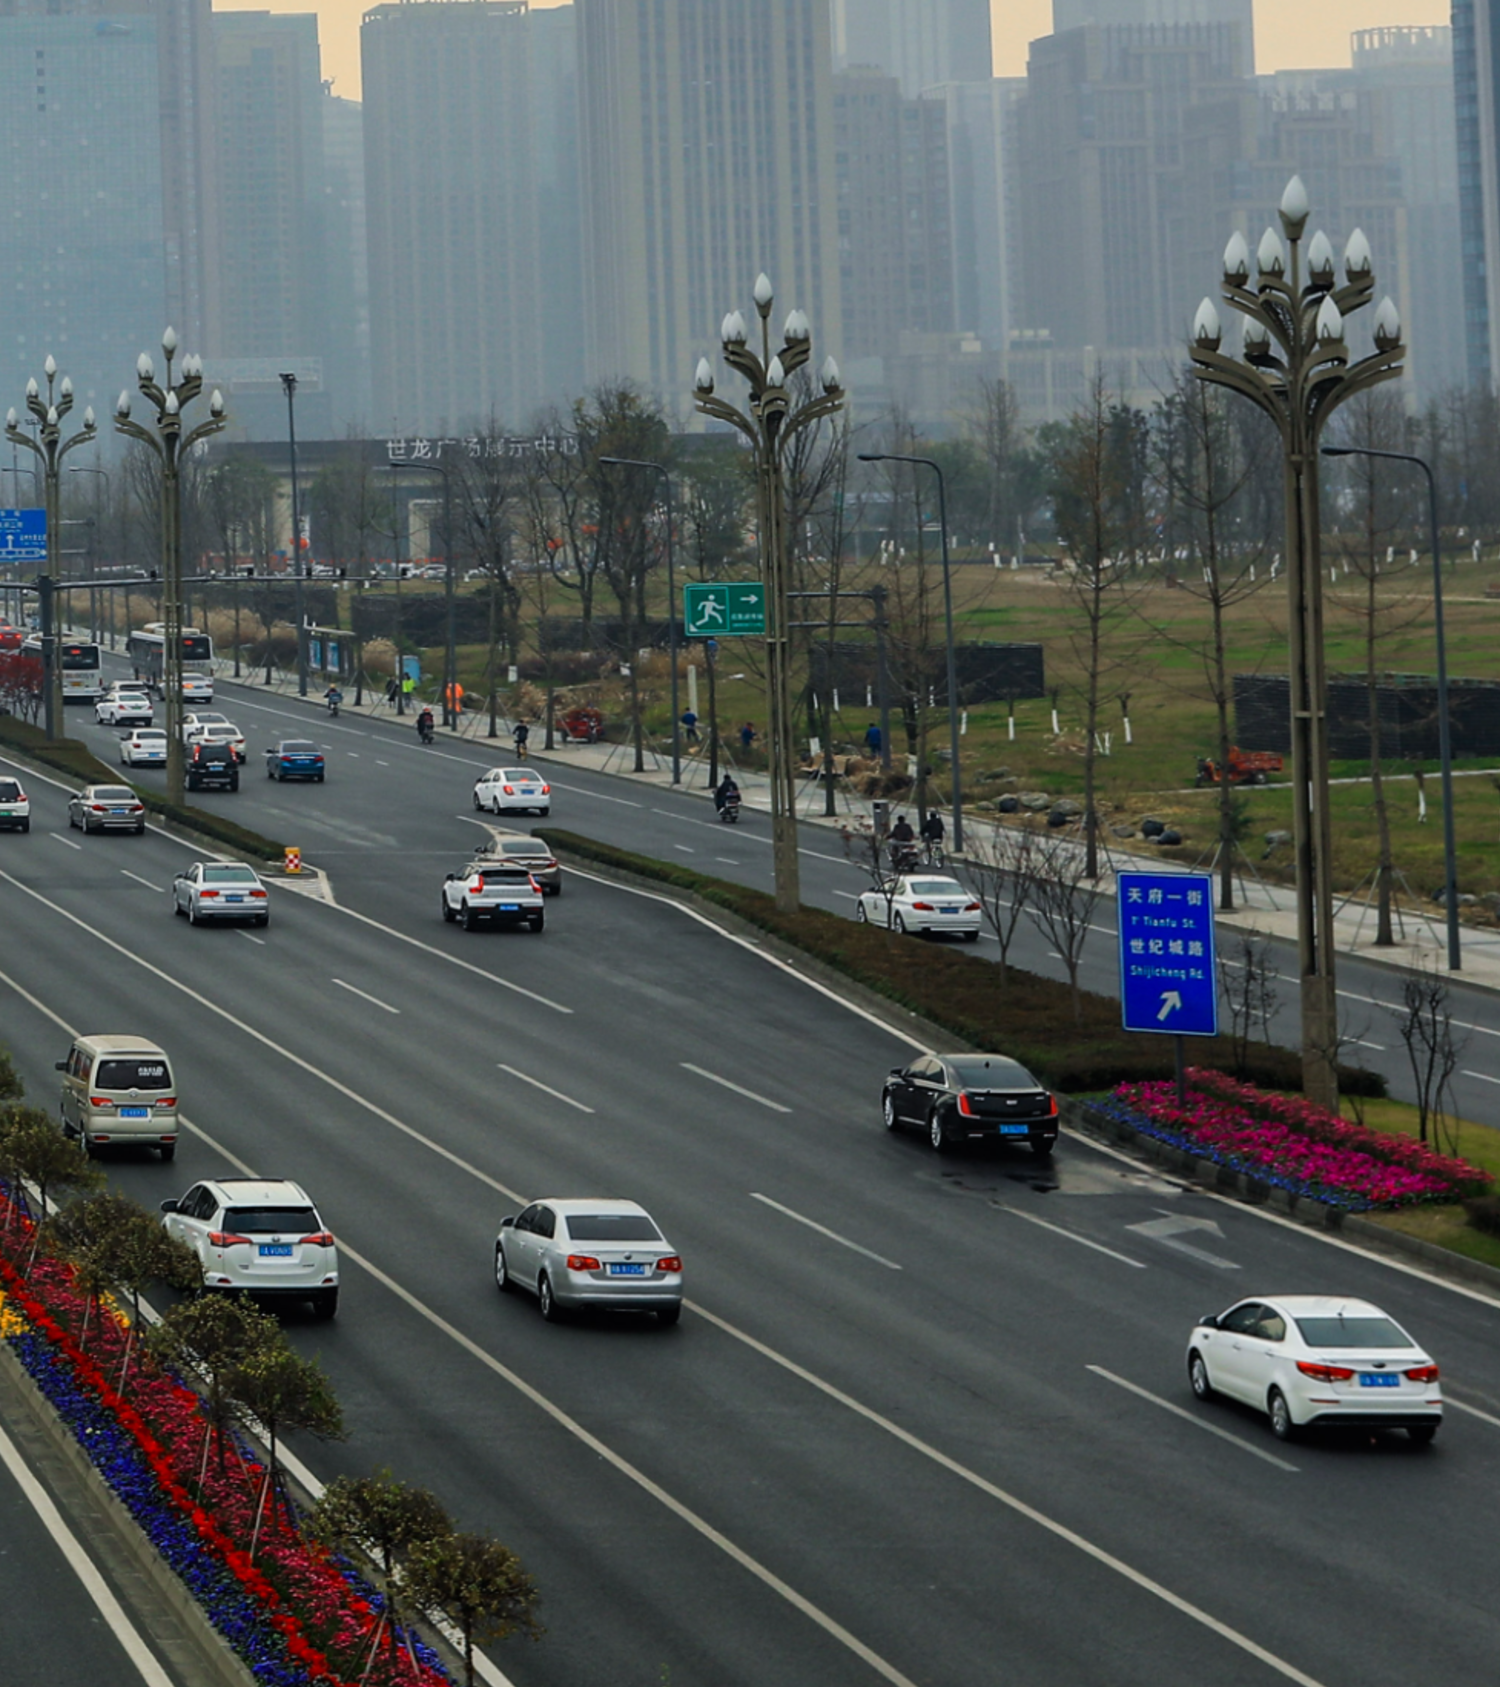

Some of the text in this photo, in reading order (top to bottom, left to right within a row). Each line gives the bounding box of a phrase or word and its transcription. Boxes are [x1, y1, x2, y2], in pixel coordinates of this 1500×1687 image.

[1127, 888, 1203, 906] 天府一街
[1143, 915, 1177, 928] Tianfu
[1129, 938, 1204, 957] 世纪城路
[1130, 965, 1187, 981] Shijicheng
